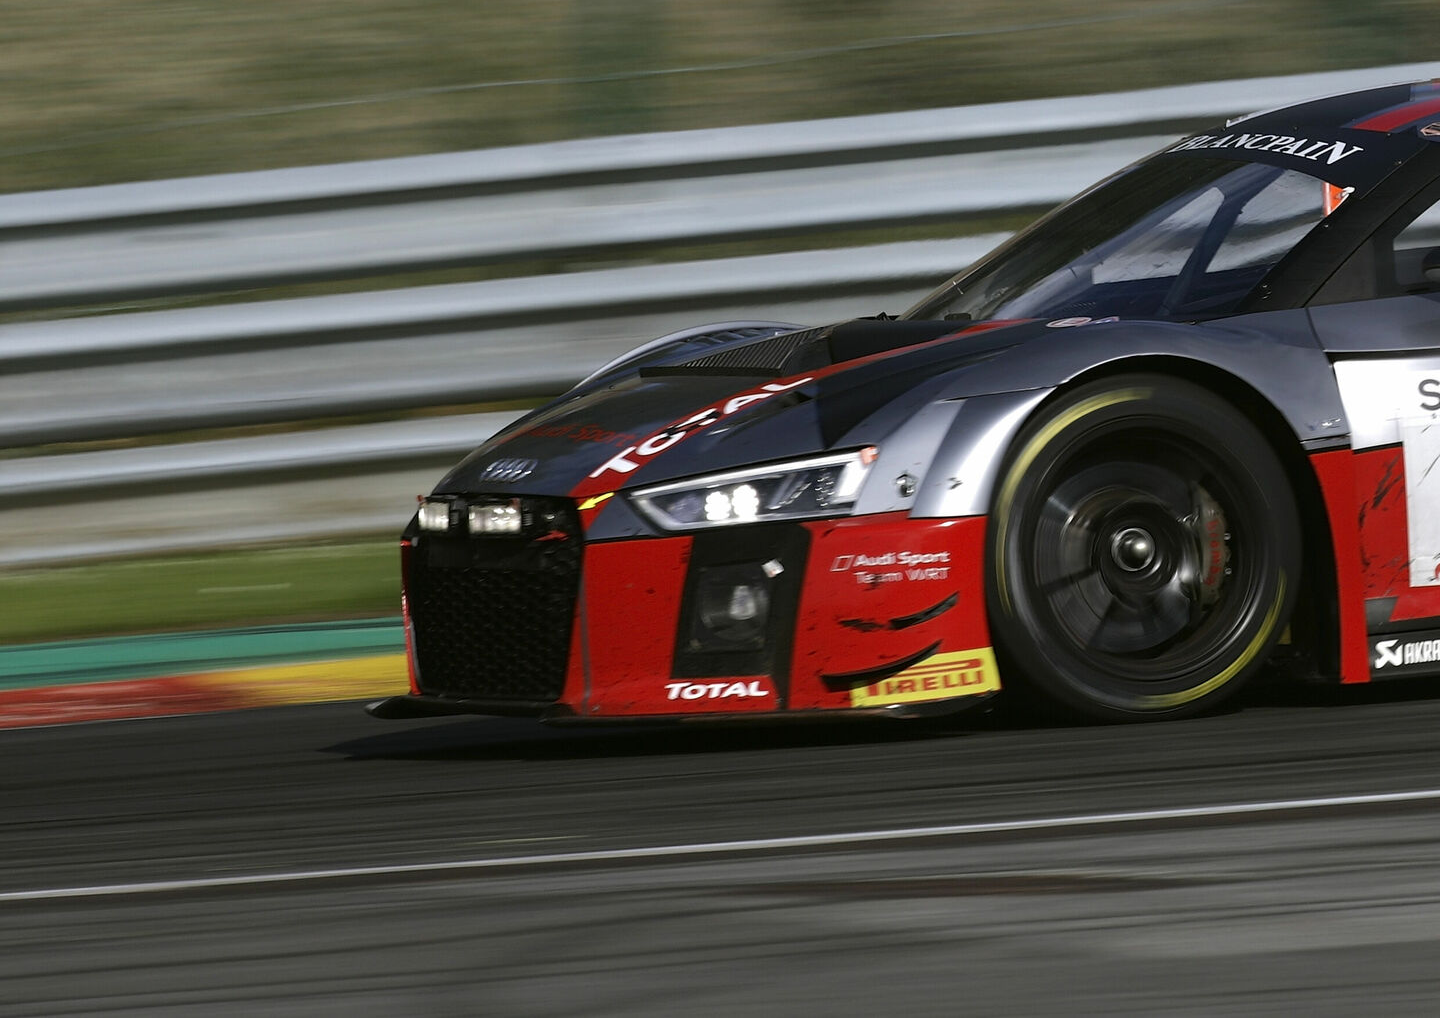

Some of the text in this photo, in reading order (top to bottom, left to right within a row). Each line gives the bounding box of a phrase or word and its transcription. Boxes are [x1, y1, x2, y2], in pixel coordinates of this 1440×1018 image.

[1165, 132, 1364, 166] BLANCPAIN
[588, 376, 814, 479] TOTAL
[852, 550, 952, 567] Audi Sport
[853, 566, 952, 585] Team WRT
[664, 680, 770, 701] TOTAL
